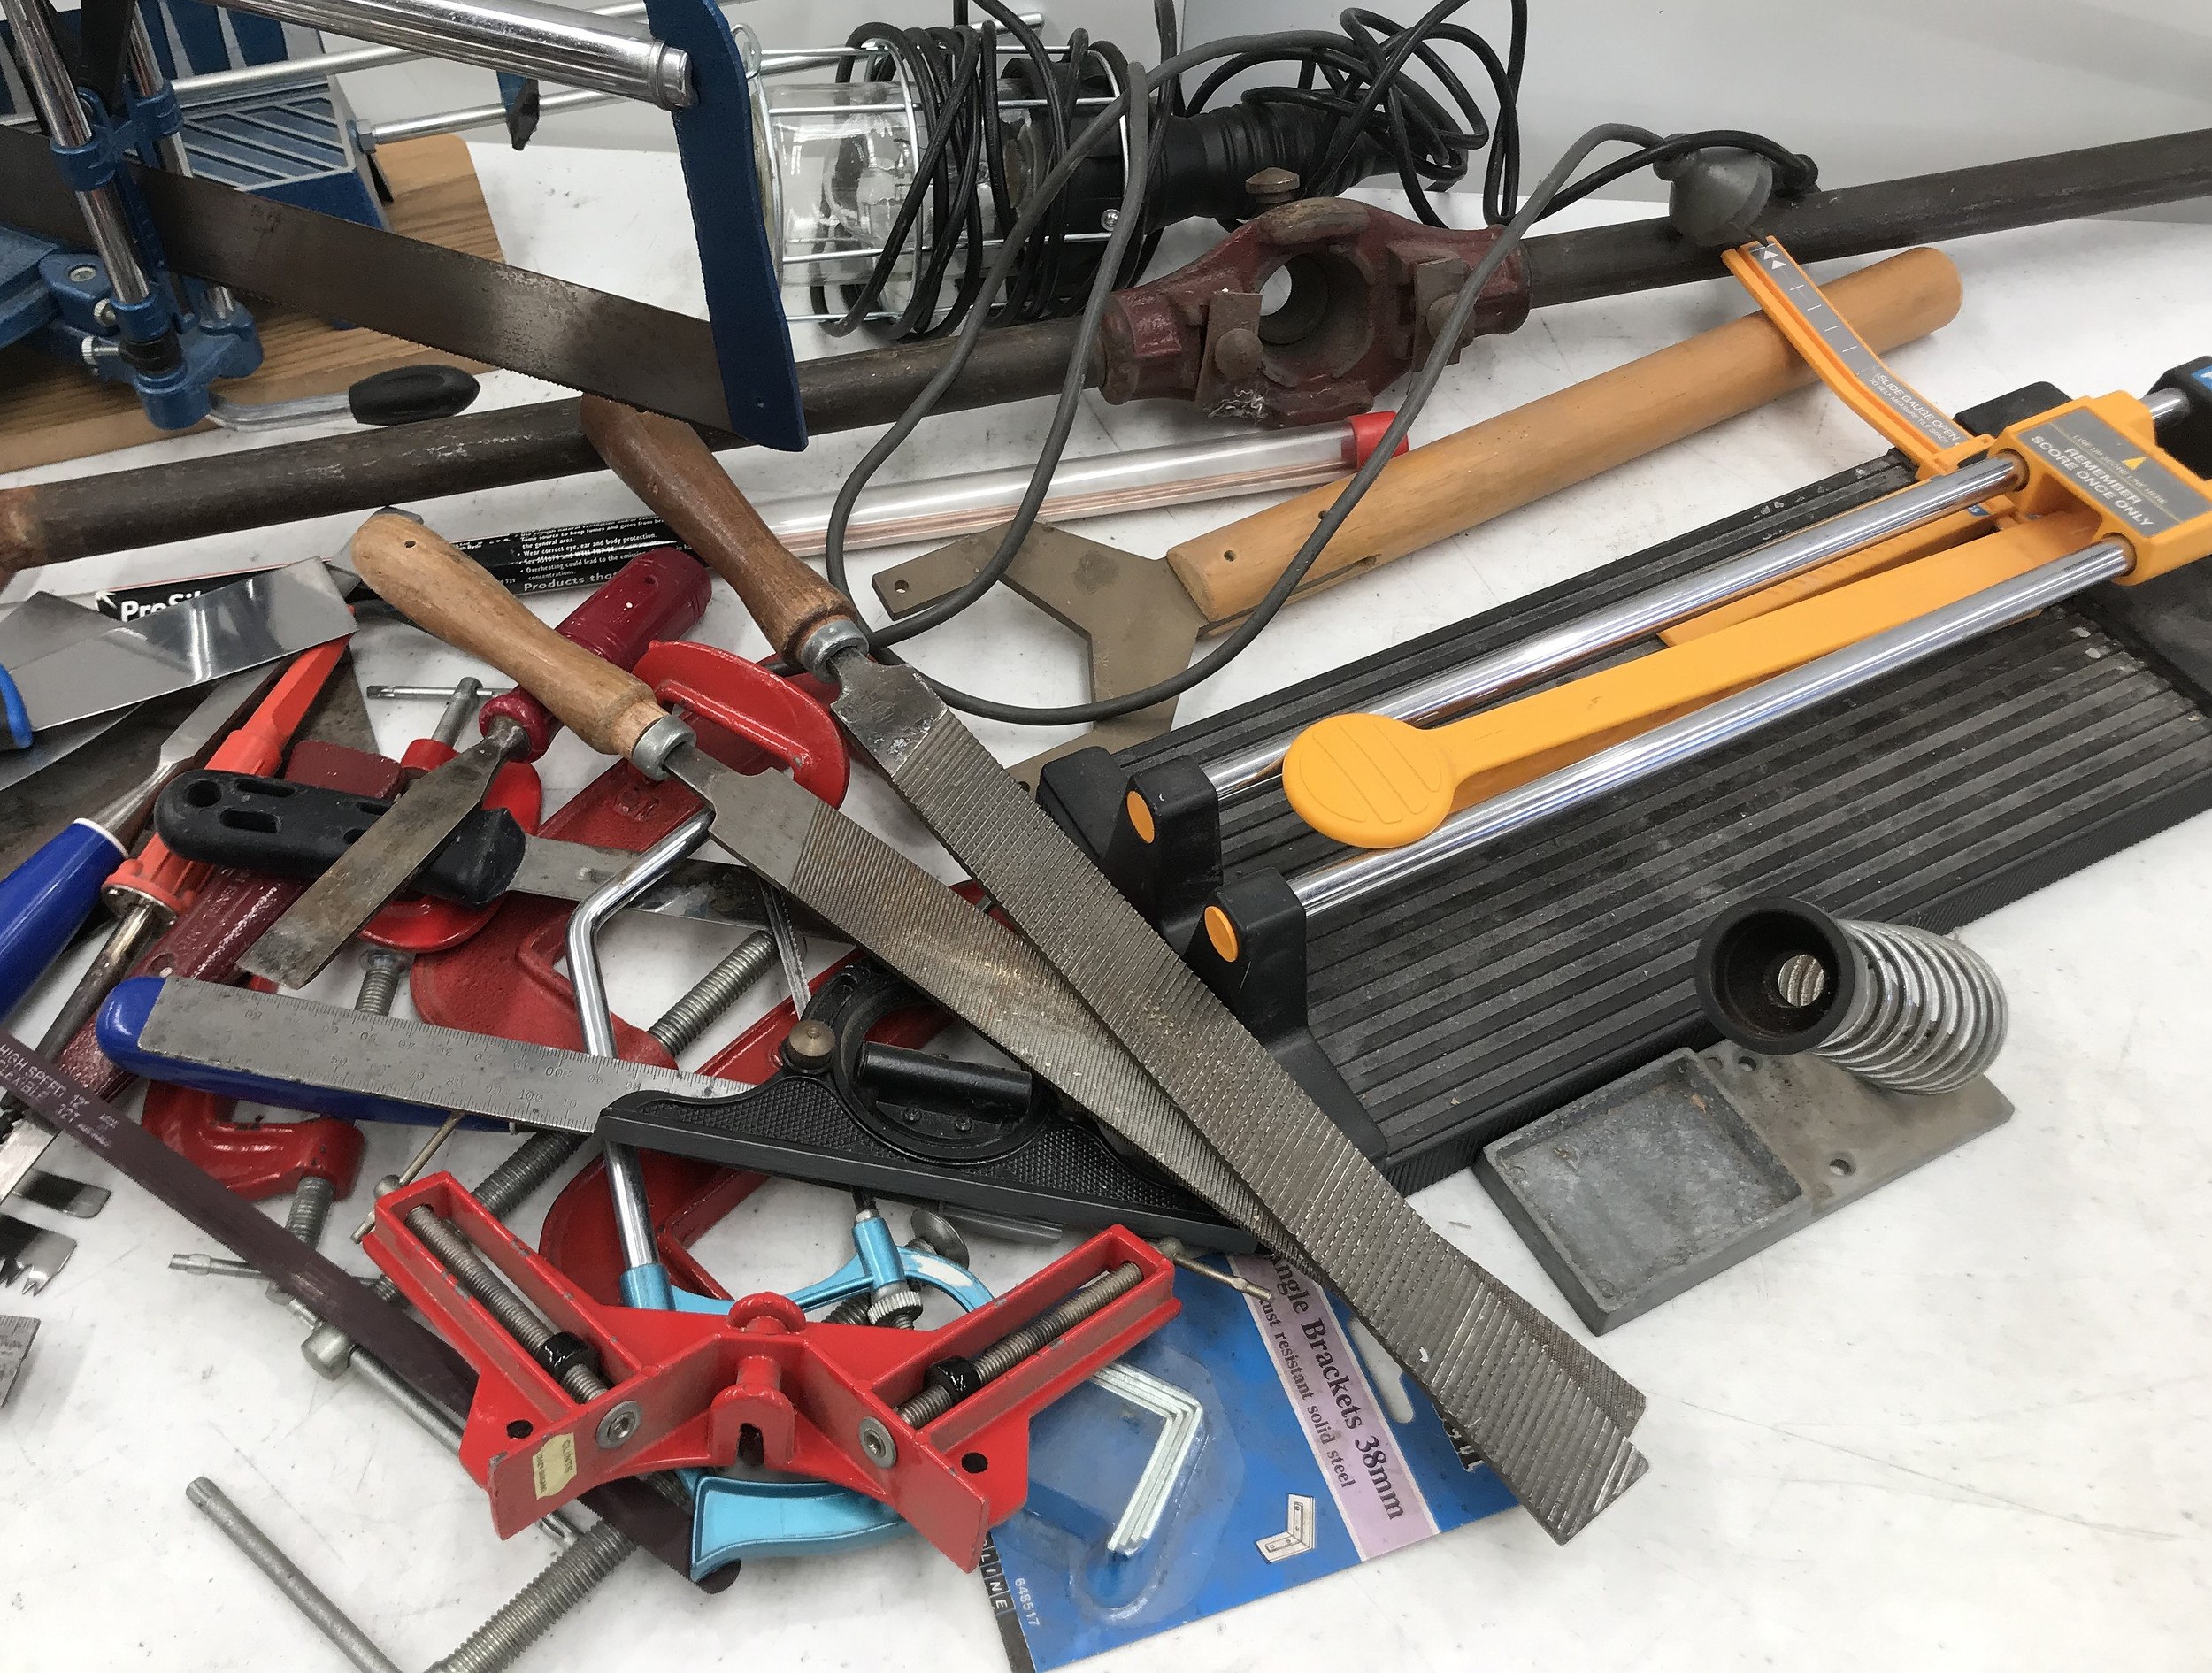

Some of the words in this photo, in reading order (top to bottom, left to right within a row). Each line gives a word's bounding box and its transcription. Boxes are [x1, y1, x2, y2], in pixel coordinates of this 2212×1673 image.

[1877, 373, 1904, 396] SLIDE
[1901, 395, 1935, 420] GAUGE
[1932, 419, 1961, 441] OPEN
[2031, 435, 2079, 472] SCORE
[2076, 470, 2117, 500] ONCE
[2114, 499, 2154, 526] ONLY
[2064, 448, 2142, 504] REMEMBER
[526, 563, 565, 574] Overheating
[565, 558, 582, 568] could
[583, 556, 597, 565] lead
[593, 539, 604, 548] and
[606, 537, 621, 546] body
[623, 533, 657, 543] protection.
[524, 576, 586, 592] Products
[0, 1044, 28, 1071] HIGH
[25, 1066, 67, 1098] SPEED
[518, 1090, 544, 1103] 100
[545, 1067, 574, 1078] 200
[1274, 1331, 1315, 1401] resistant
[1307, 1405, 1337, 1446] solid
[1327, 1449, 1357, 1488] steel
[1301, 1317, 1363, 1431] Brackets
[1355, 1435, 1405, 1521] 38mm
[562, 1439, 573, 1474] CLINTS
[981, 1539, 1008, 1608] LINE
